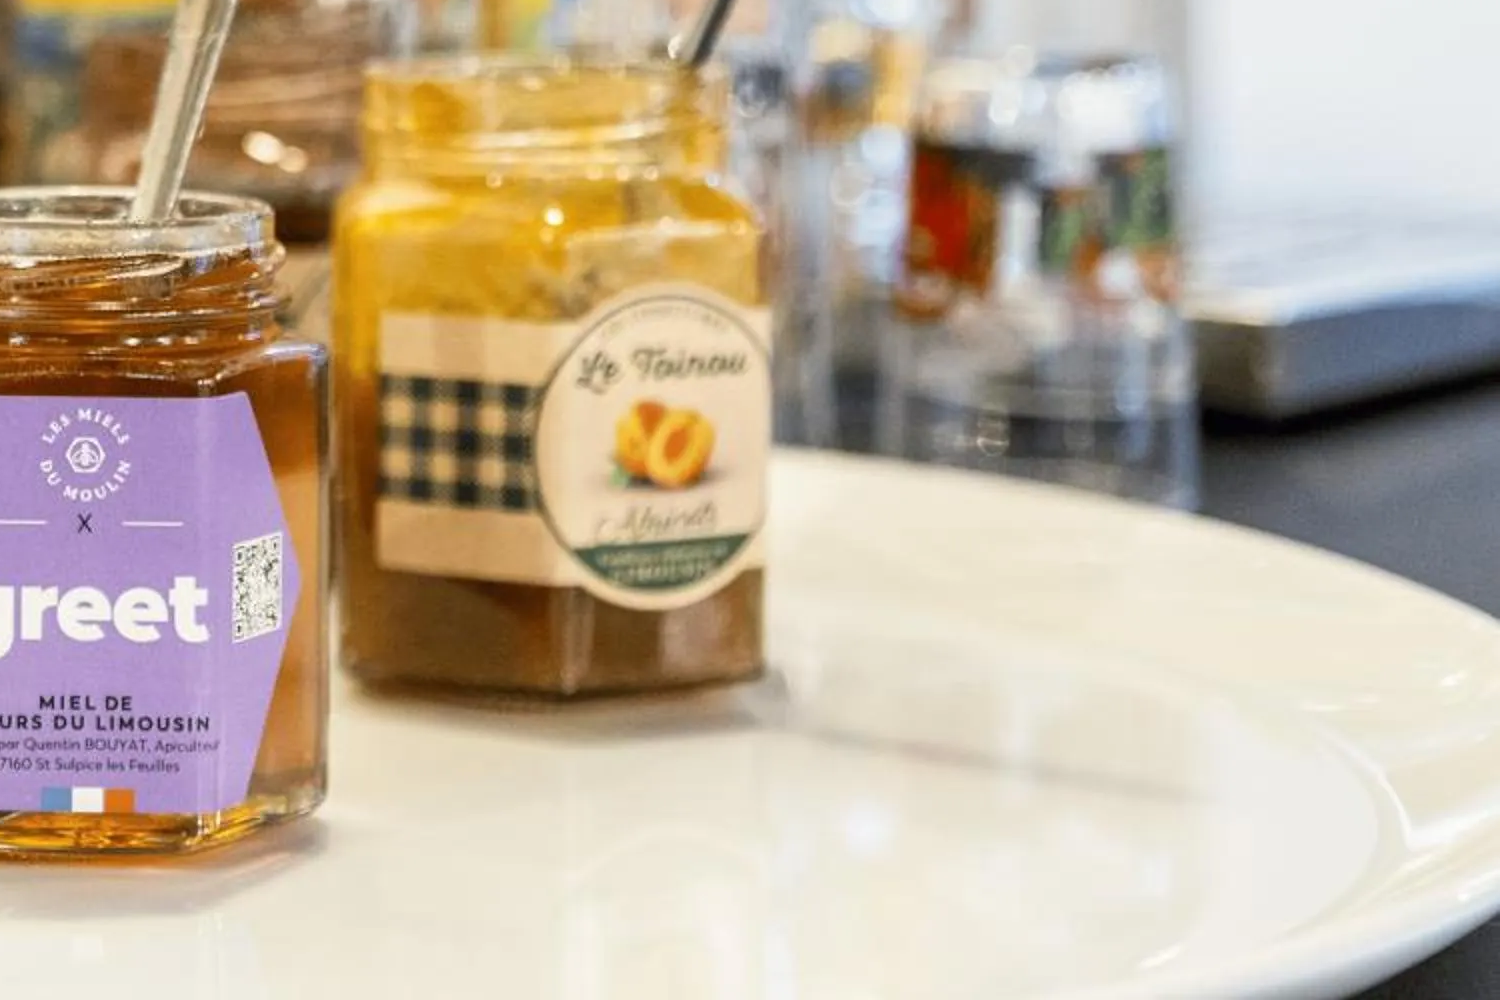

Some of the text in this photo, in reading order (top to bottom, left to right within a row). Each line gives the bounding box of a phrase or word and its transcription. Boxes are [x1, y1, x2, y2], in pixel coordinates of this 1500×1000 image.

[42, 407, 130, 444] LES MIELS
[40, 460, 131, 502] DU MOULIN
[39, 695, 132, 711] MIEL DE
[54, 715, 85, 730] DU
[95, 716, 210, 732] LIMOUSIN
[23, 737, 81, 752] Quentin
[37, 757, 50, 771] St
[56, 757, 101, 773] Sulpice
[106, 757, 125, 772] les
[129, 759, 180, 773] Feuilles
